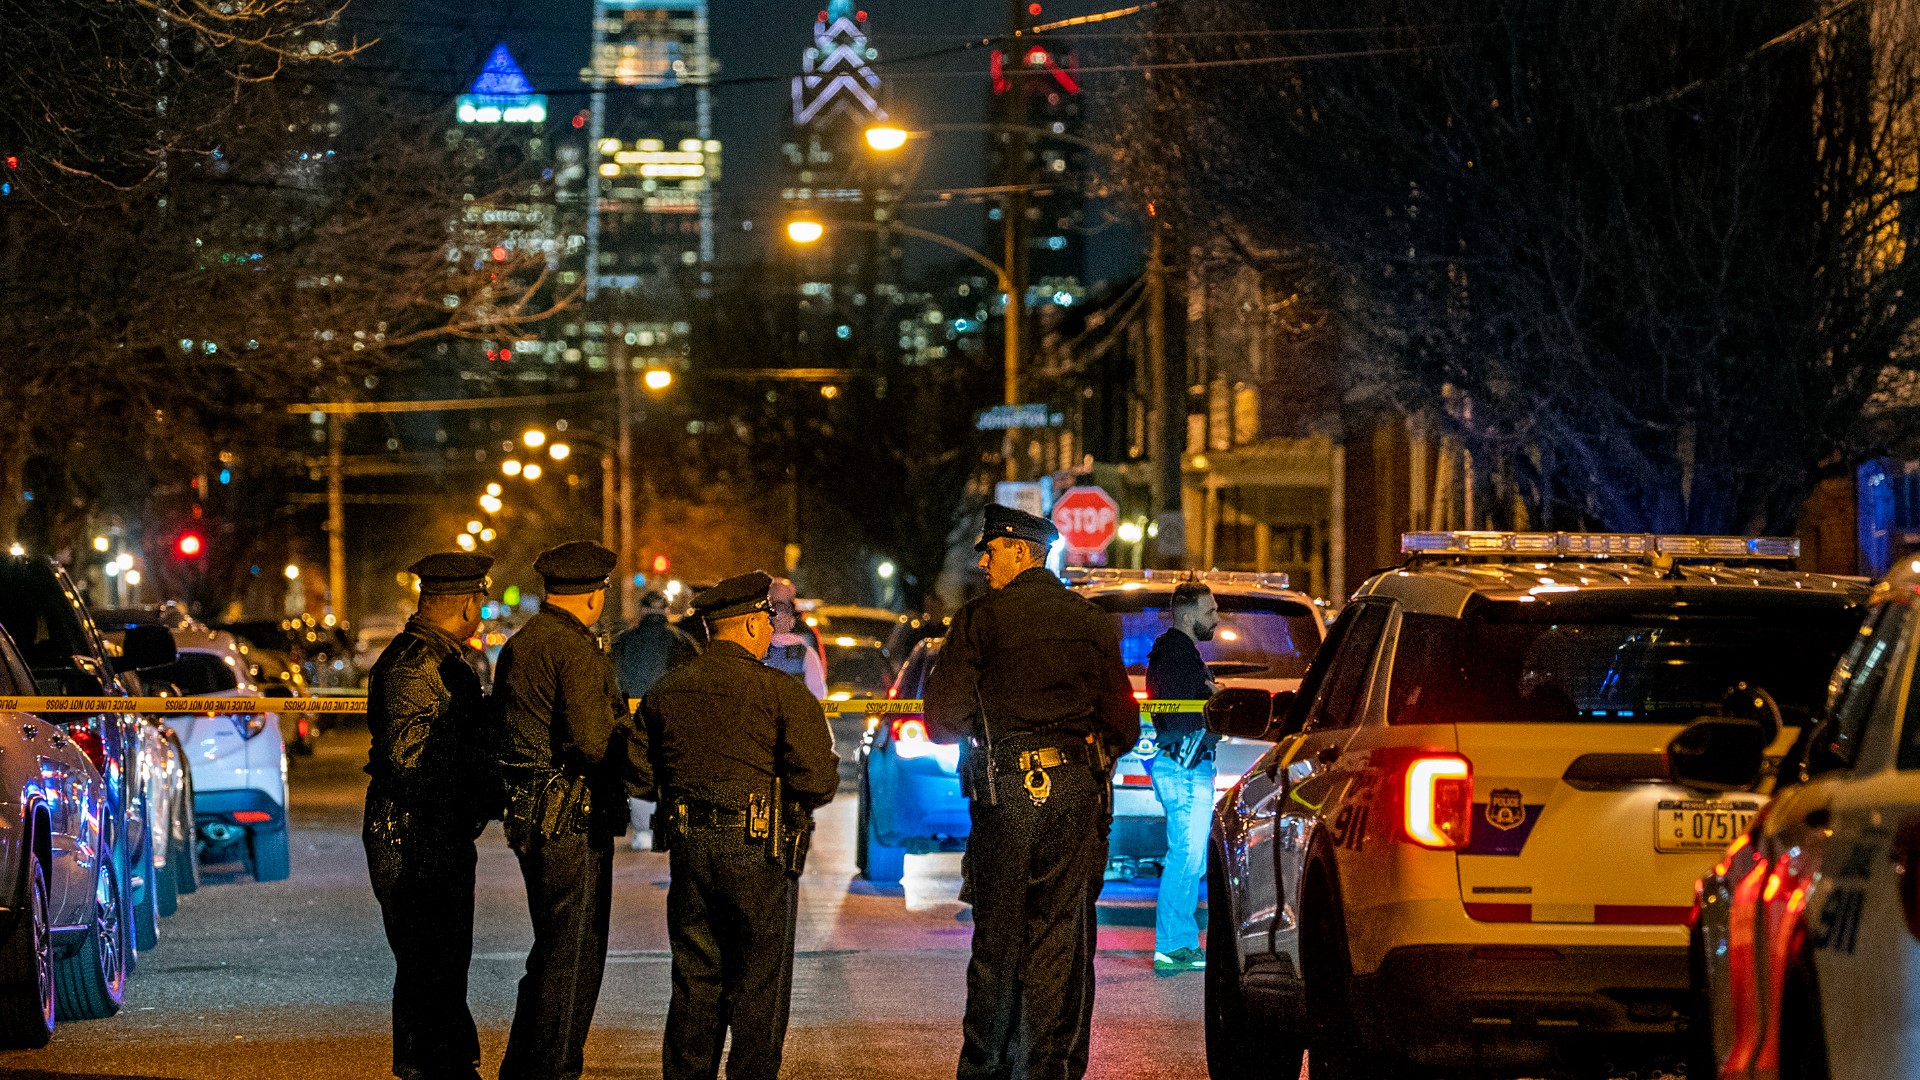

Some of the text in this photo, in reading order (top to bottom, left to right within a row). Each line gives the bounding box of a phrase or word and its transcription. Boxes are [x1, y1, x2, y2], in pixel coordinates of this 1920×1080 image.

[1057, 507, 1113, 534] STOP
[45, 699, 137, 710] POLICE LINE DO NOT CROSS
[164, 700, 256, 711] POLICE LINE DO NOT CROSS
[283, 700, 307, 711] CROSS
[306, 700, 321, 711] NOT
[321, 701, 333, 711] DO
[333, 701, 349, 711] LINE
[864, 702, 888, 712] CROSS
[888, 702, 903, 712] NOT
[902, 702, 914, 712] DO
[1141, 703, 1181, 713] POLICE LINE
[1492, 797, 1519, 807] POLICE
[1332, 804, 1370, 852] 911
[1814, 887, 1865, 955] 911
